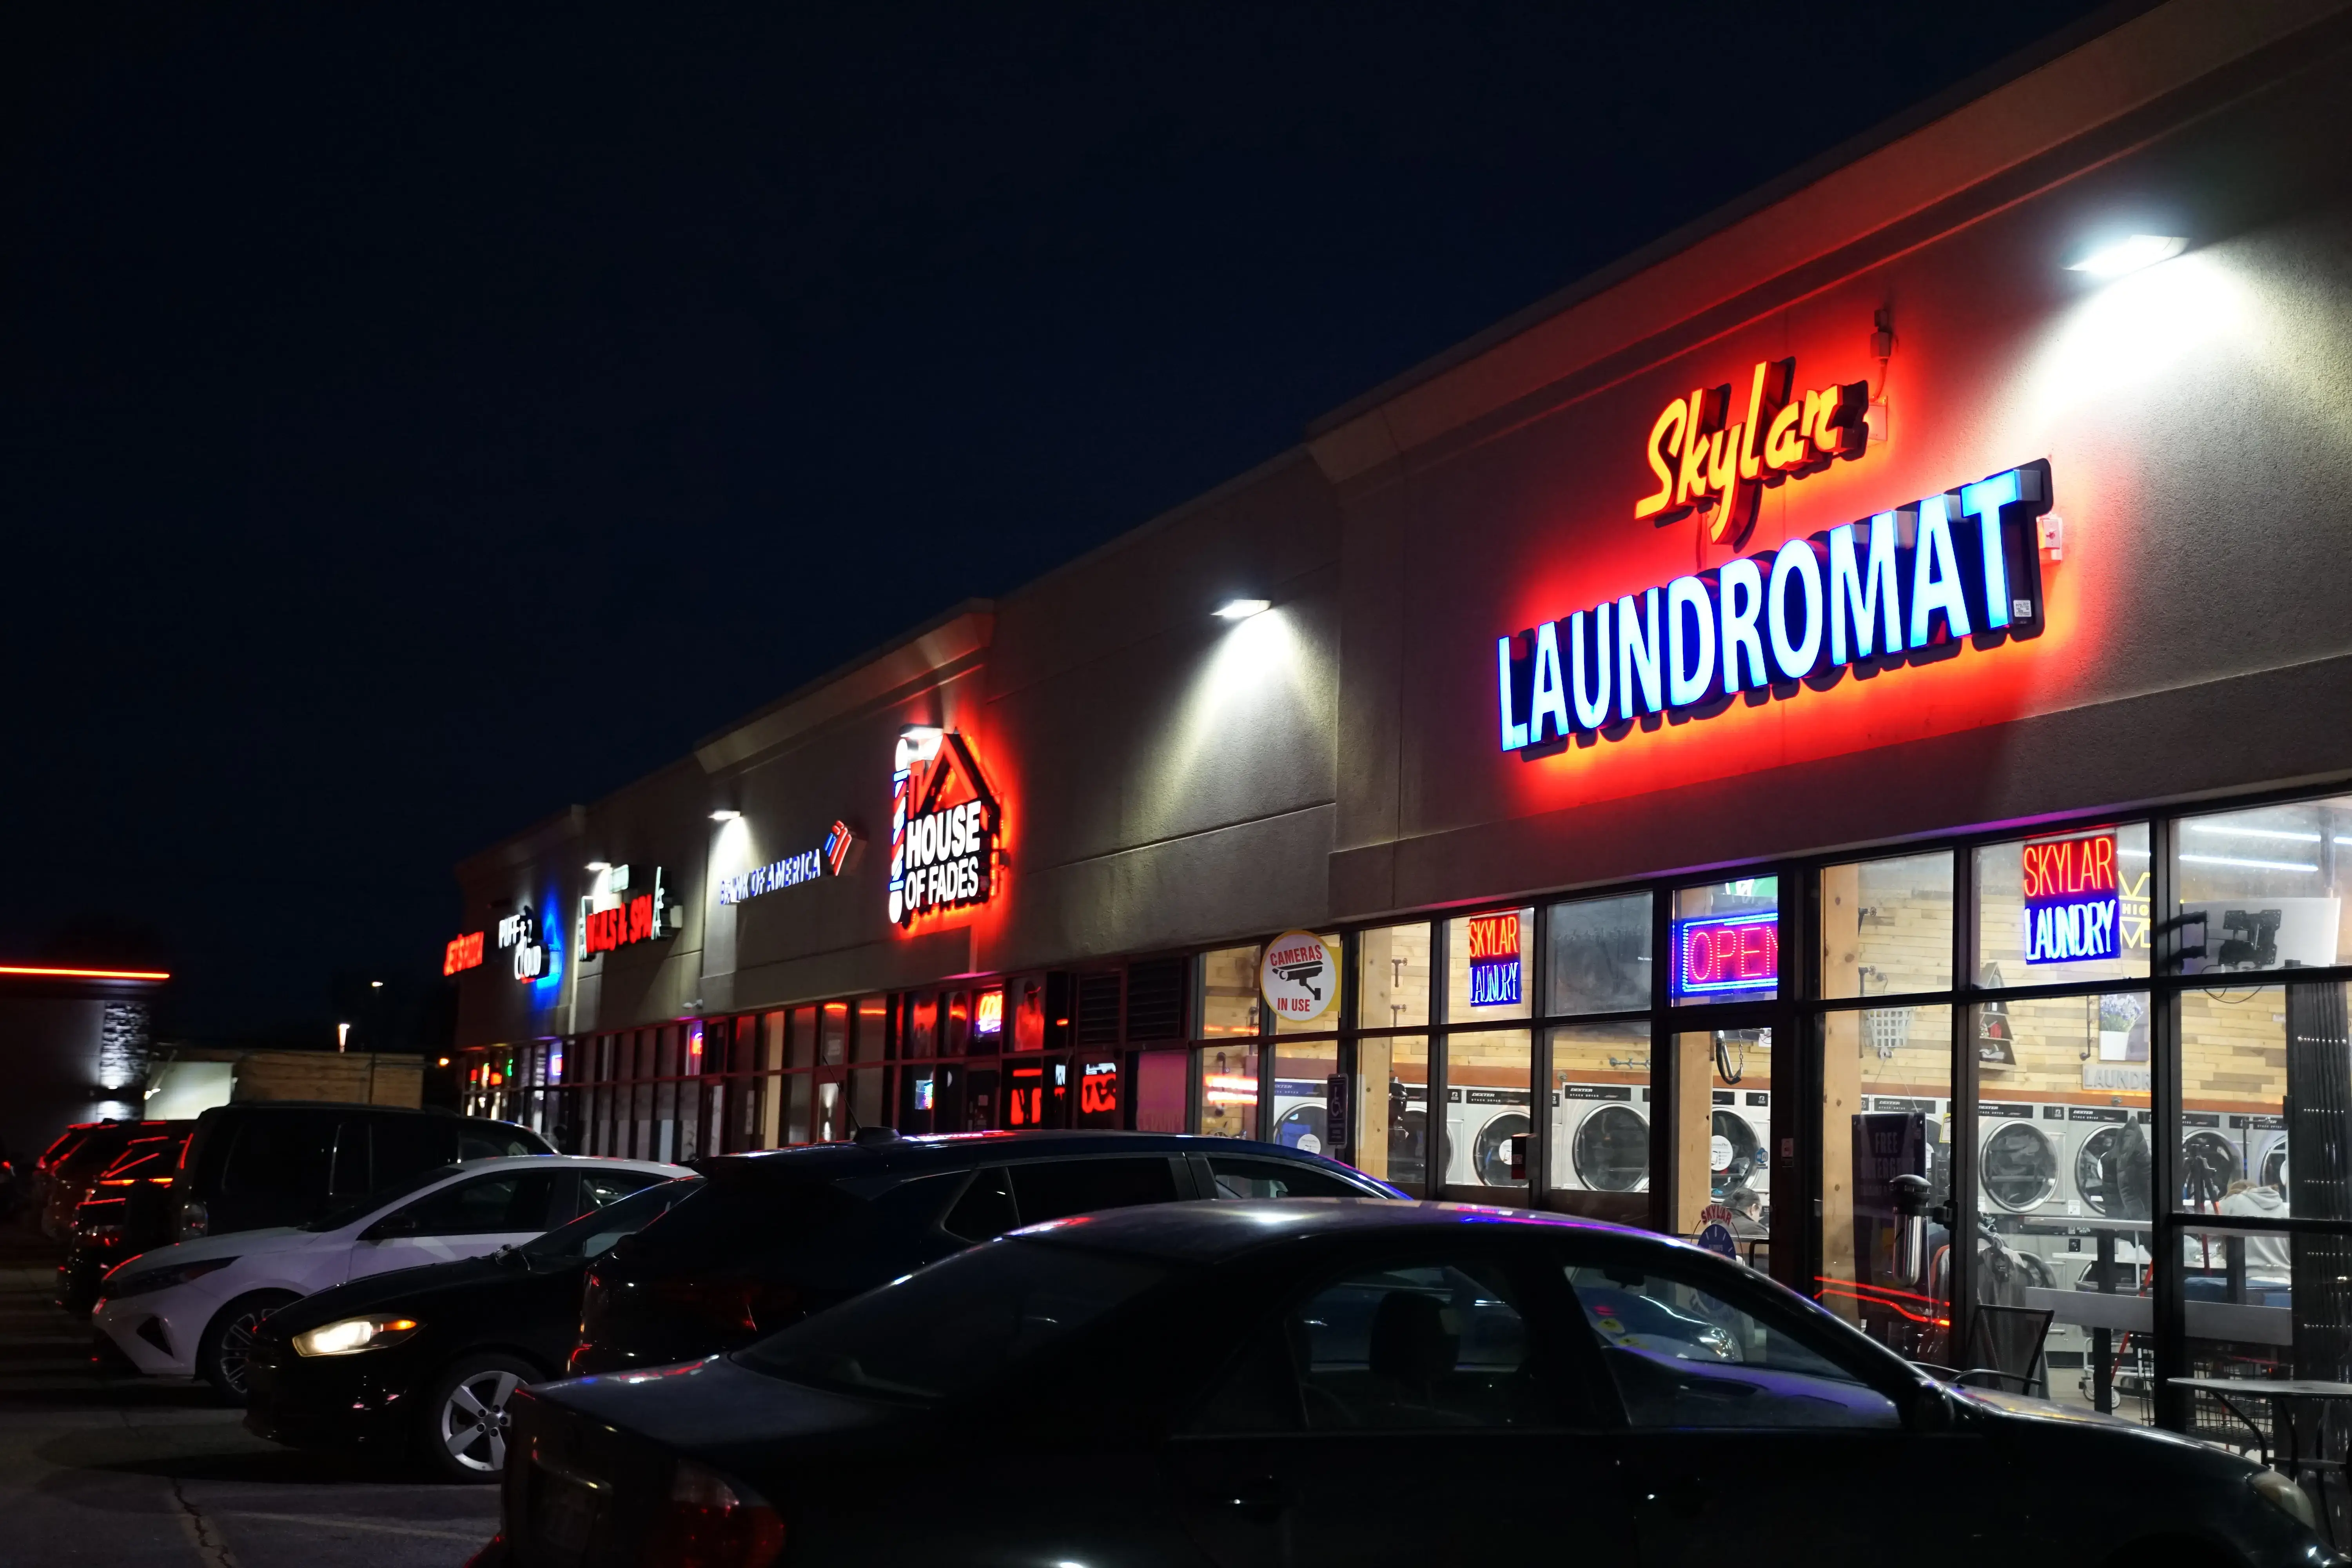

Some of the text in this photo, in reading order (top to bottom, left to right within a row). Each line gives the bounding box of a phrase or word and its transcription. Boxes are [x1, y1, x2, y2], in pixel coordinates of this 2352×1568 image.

[1635, 361, 1839, 545] Skylar
[1497, 469, 2018, 753] LAUNDROMAT
[906, 801, 982, 871] HOUSE
[720, 849, 820, 905] BANK OF AMERICA
[905, 856, 978, 910] OF FADES
[2023, 837, 2114, 897] SKYLAR
[1270, 945, 1323, 966] CAMERAS
[1469, 915, 1519, 958] SKYLAR
[2024, 898, 2117, 962] LAUNDRY
[1277, 998, 1310, 1012] IN USE
[1469, 962, 1519, 1004] LAUNDRY
[1875, 1132, 1898, 1153] FREE
[1701, 1204, 1733, 1227] SKYLAR
